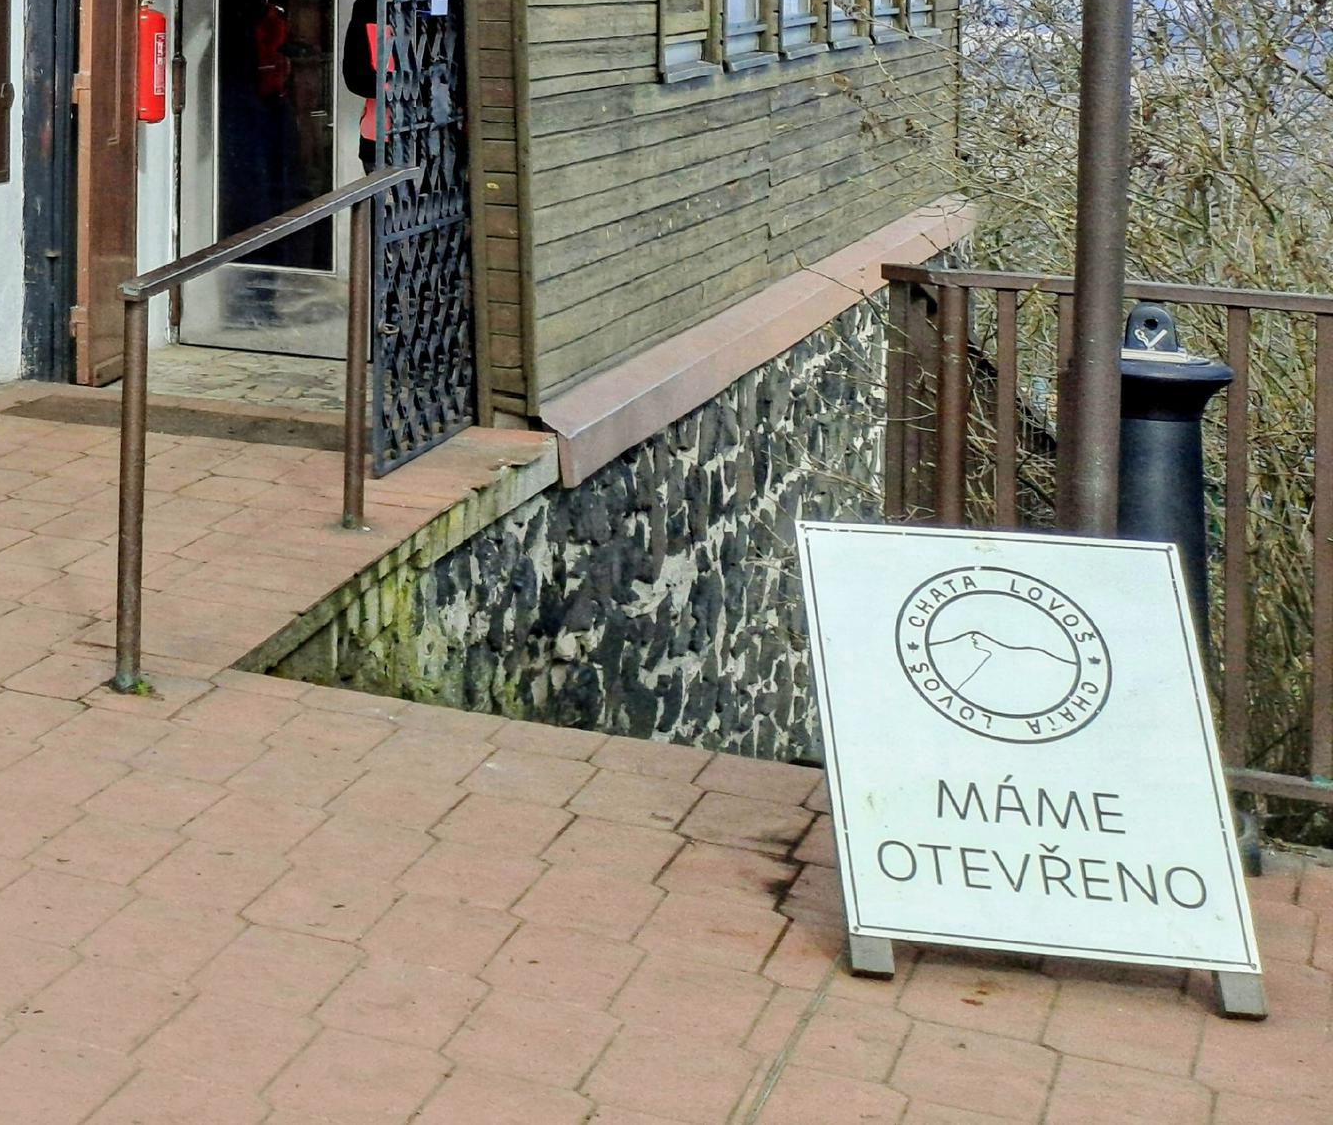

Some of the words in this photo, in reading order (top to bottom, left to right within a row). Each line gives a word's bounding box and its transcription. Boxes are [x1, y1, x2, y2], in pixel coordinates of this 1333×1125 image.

[908, 574, 978, 628] CHATA
[1009, 578, 1097, 644] LOVOŠ
[908, 661, 993, 729] LOVOŠ
[1025, 681, 1099, 735] CHATA
[935, 774, 1127, 835] MÁME
[876, 839, 1209, 910] OTEVŘENO
